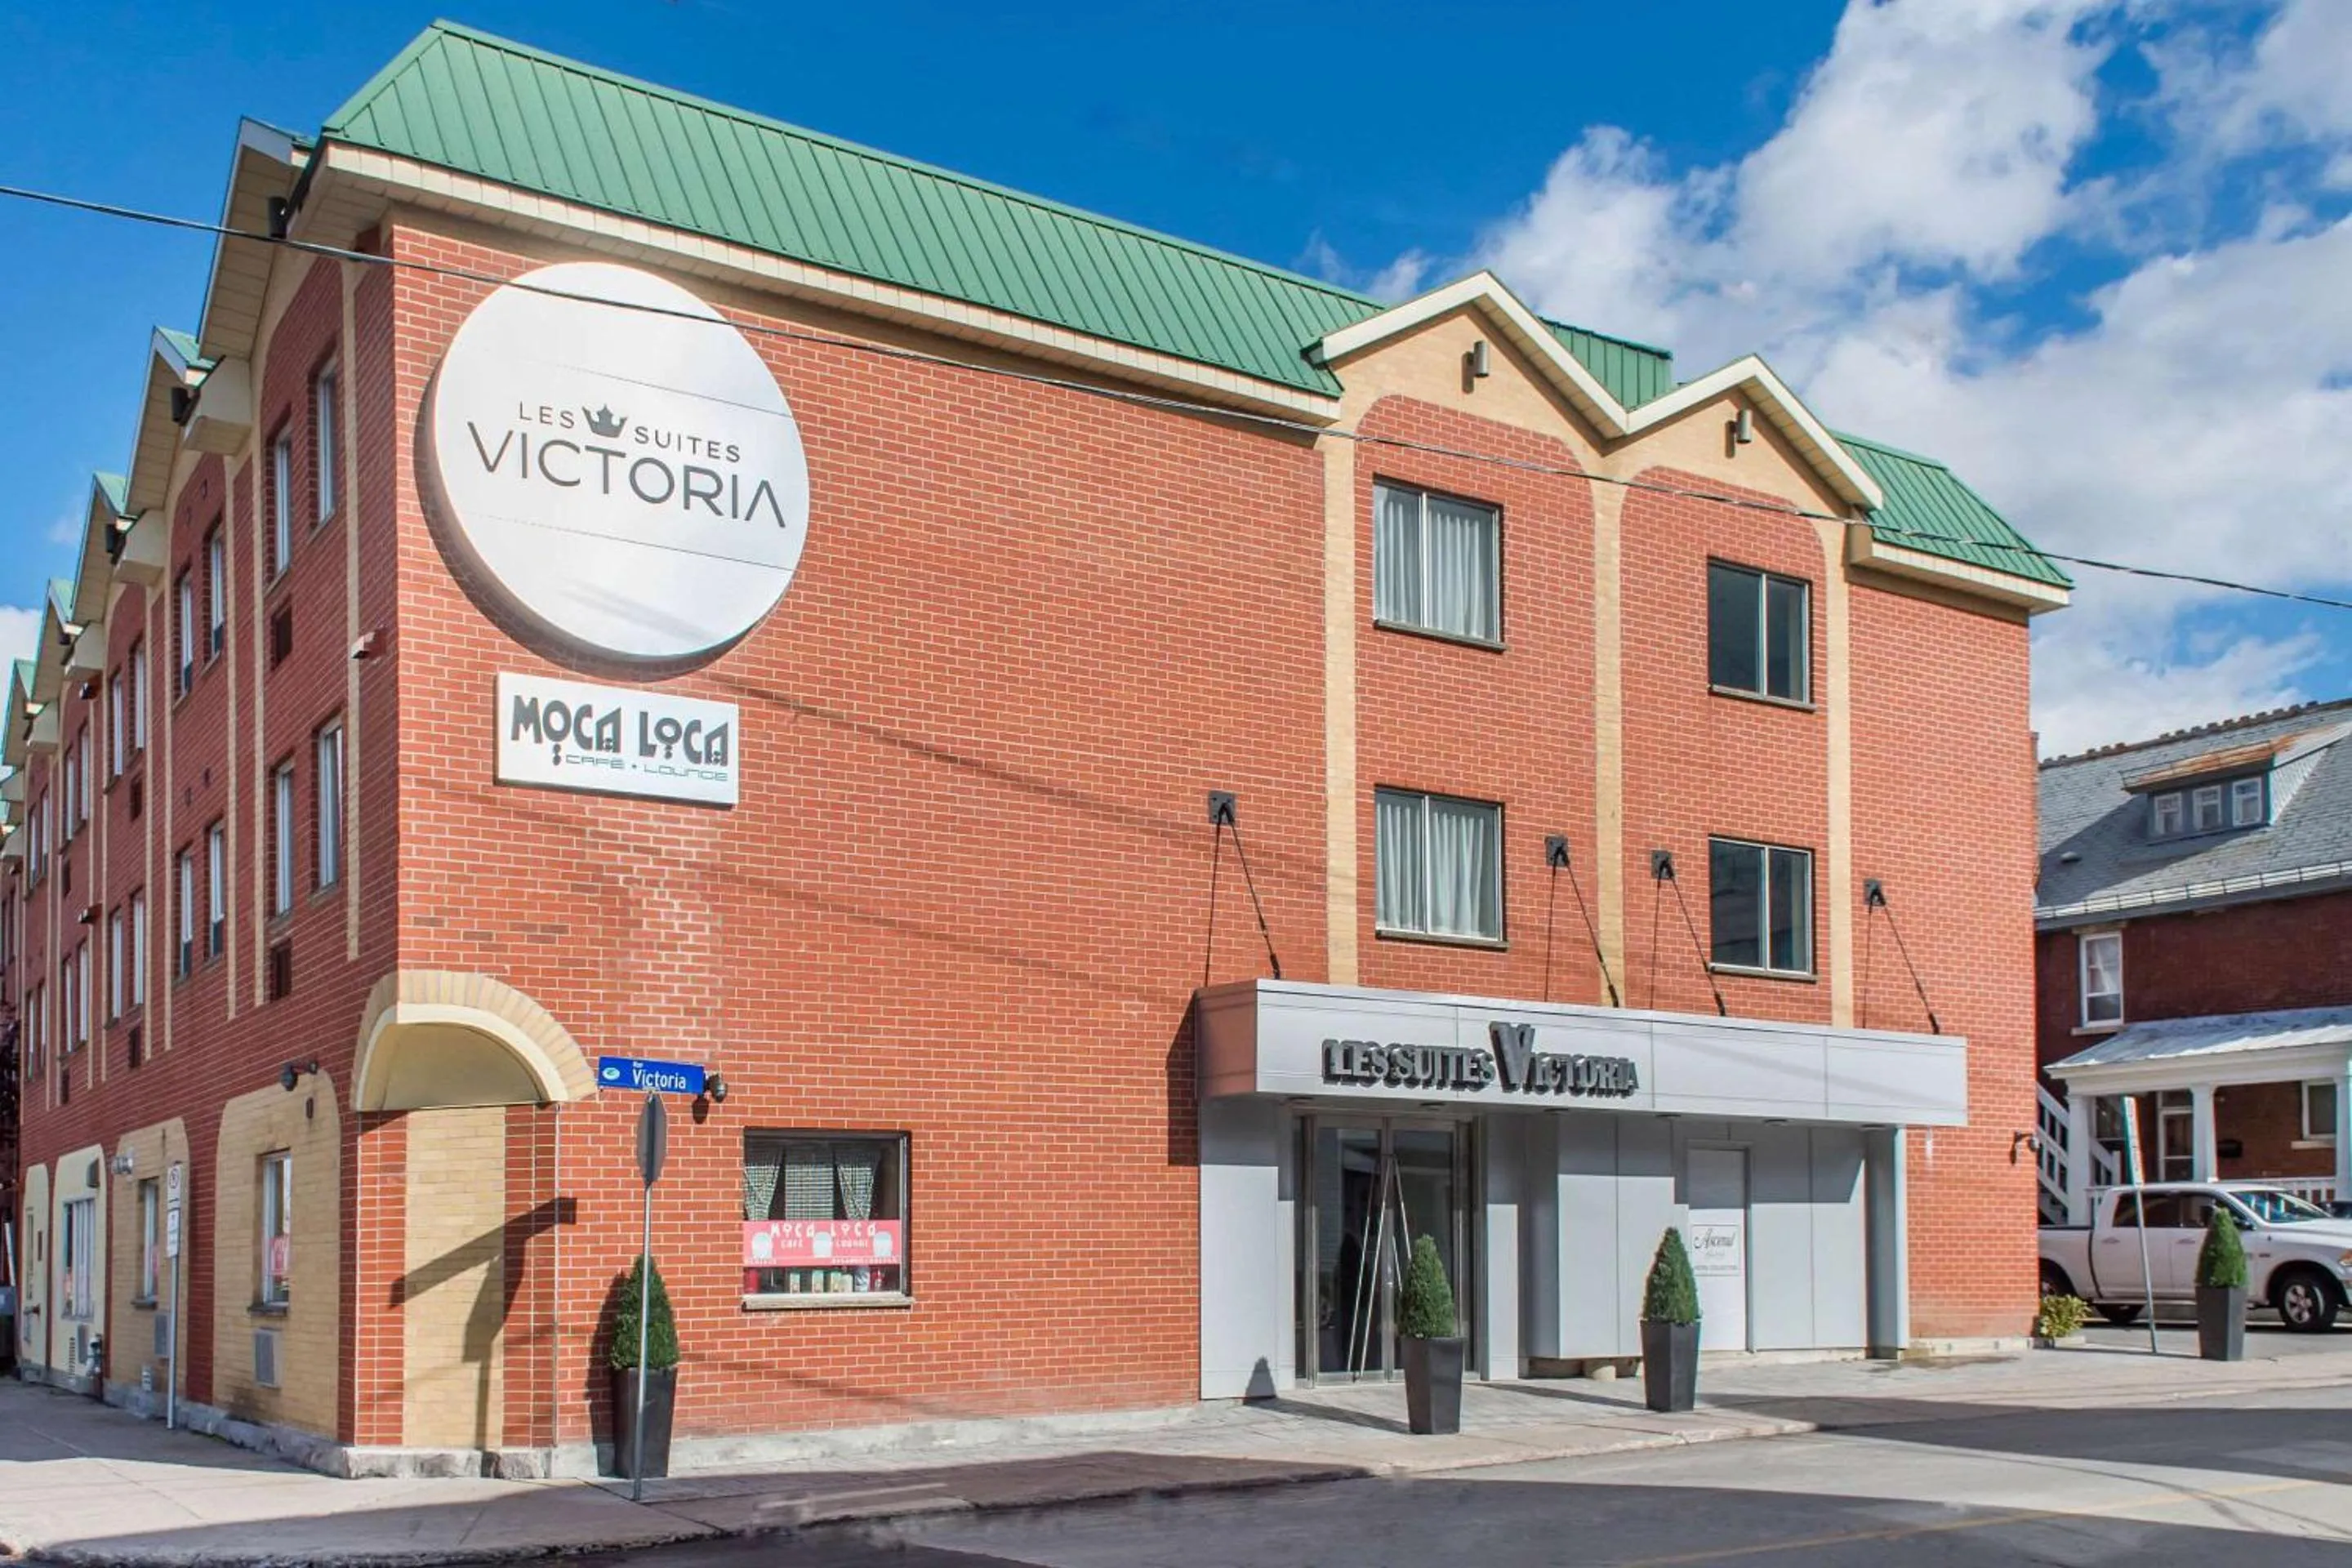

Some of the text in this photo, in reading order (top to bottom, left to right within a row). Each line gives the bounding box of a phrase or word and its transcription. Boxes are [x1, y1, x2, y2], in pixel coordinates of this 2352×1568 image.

[519, 401, 741, 462] LES SUITES
[466, 421, 786, 528] VICTORIA
[510, 695, 728, 767] MOCA LOCA
[632, 1068, 687, 1089] Victoria
[1321, 1021, 1639, 1098] LES SUITES VICTORIA
